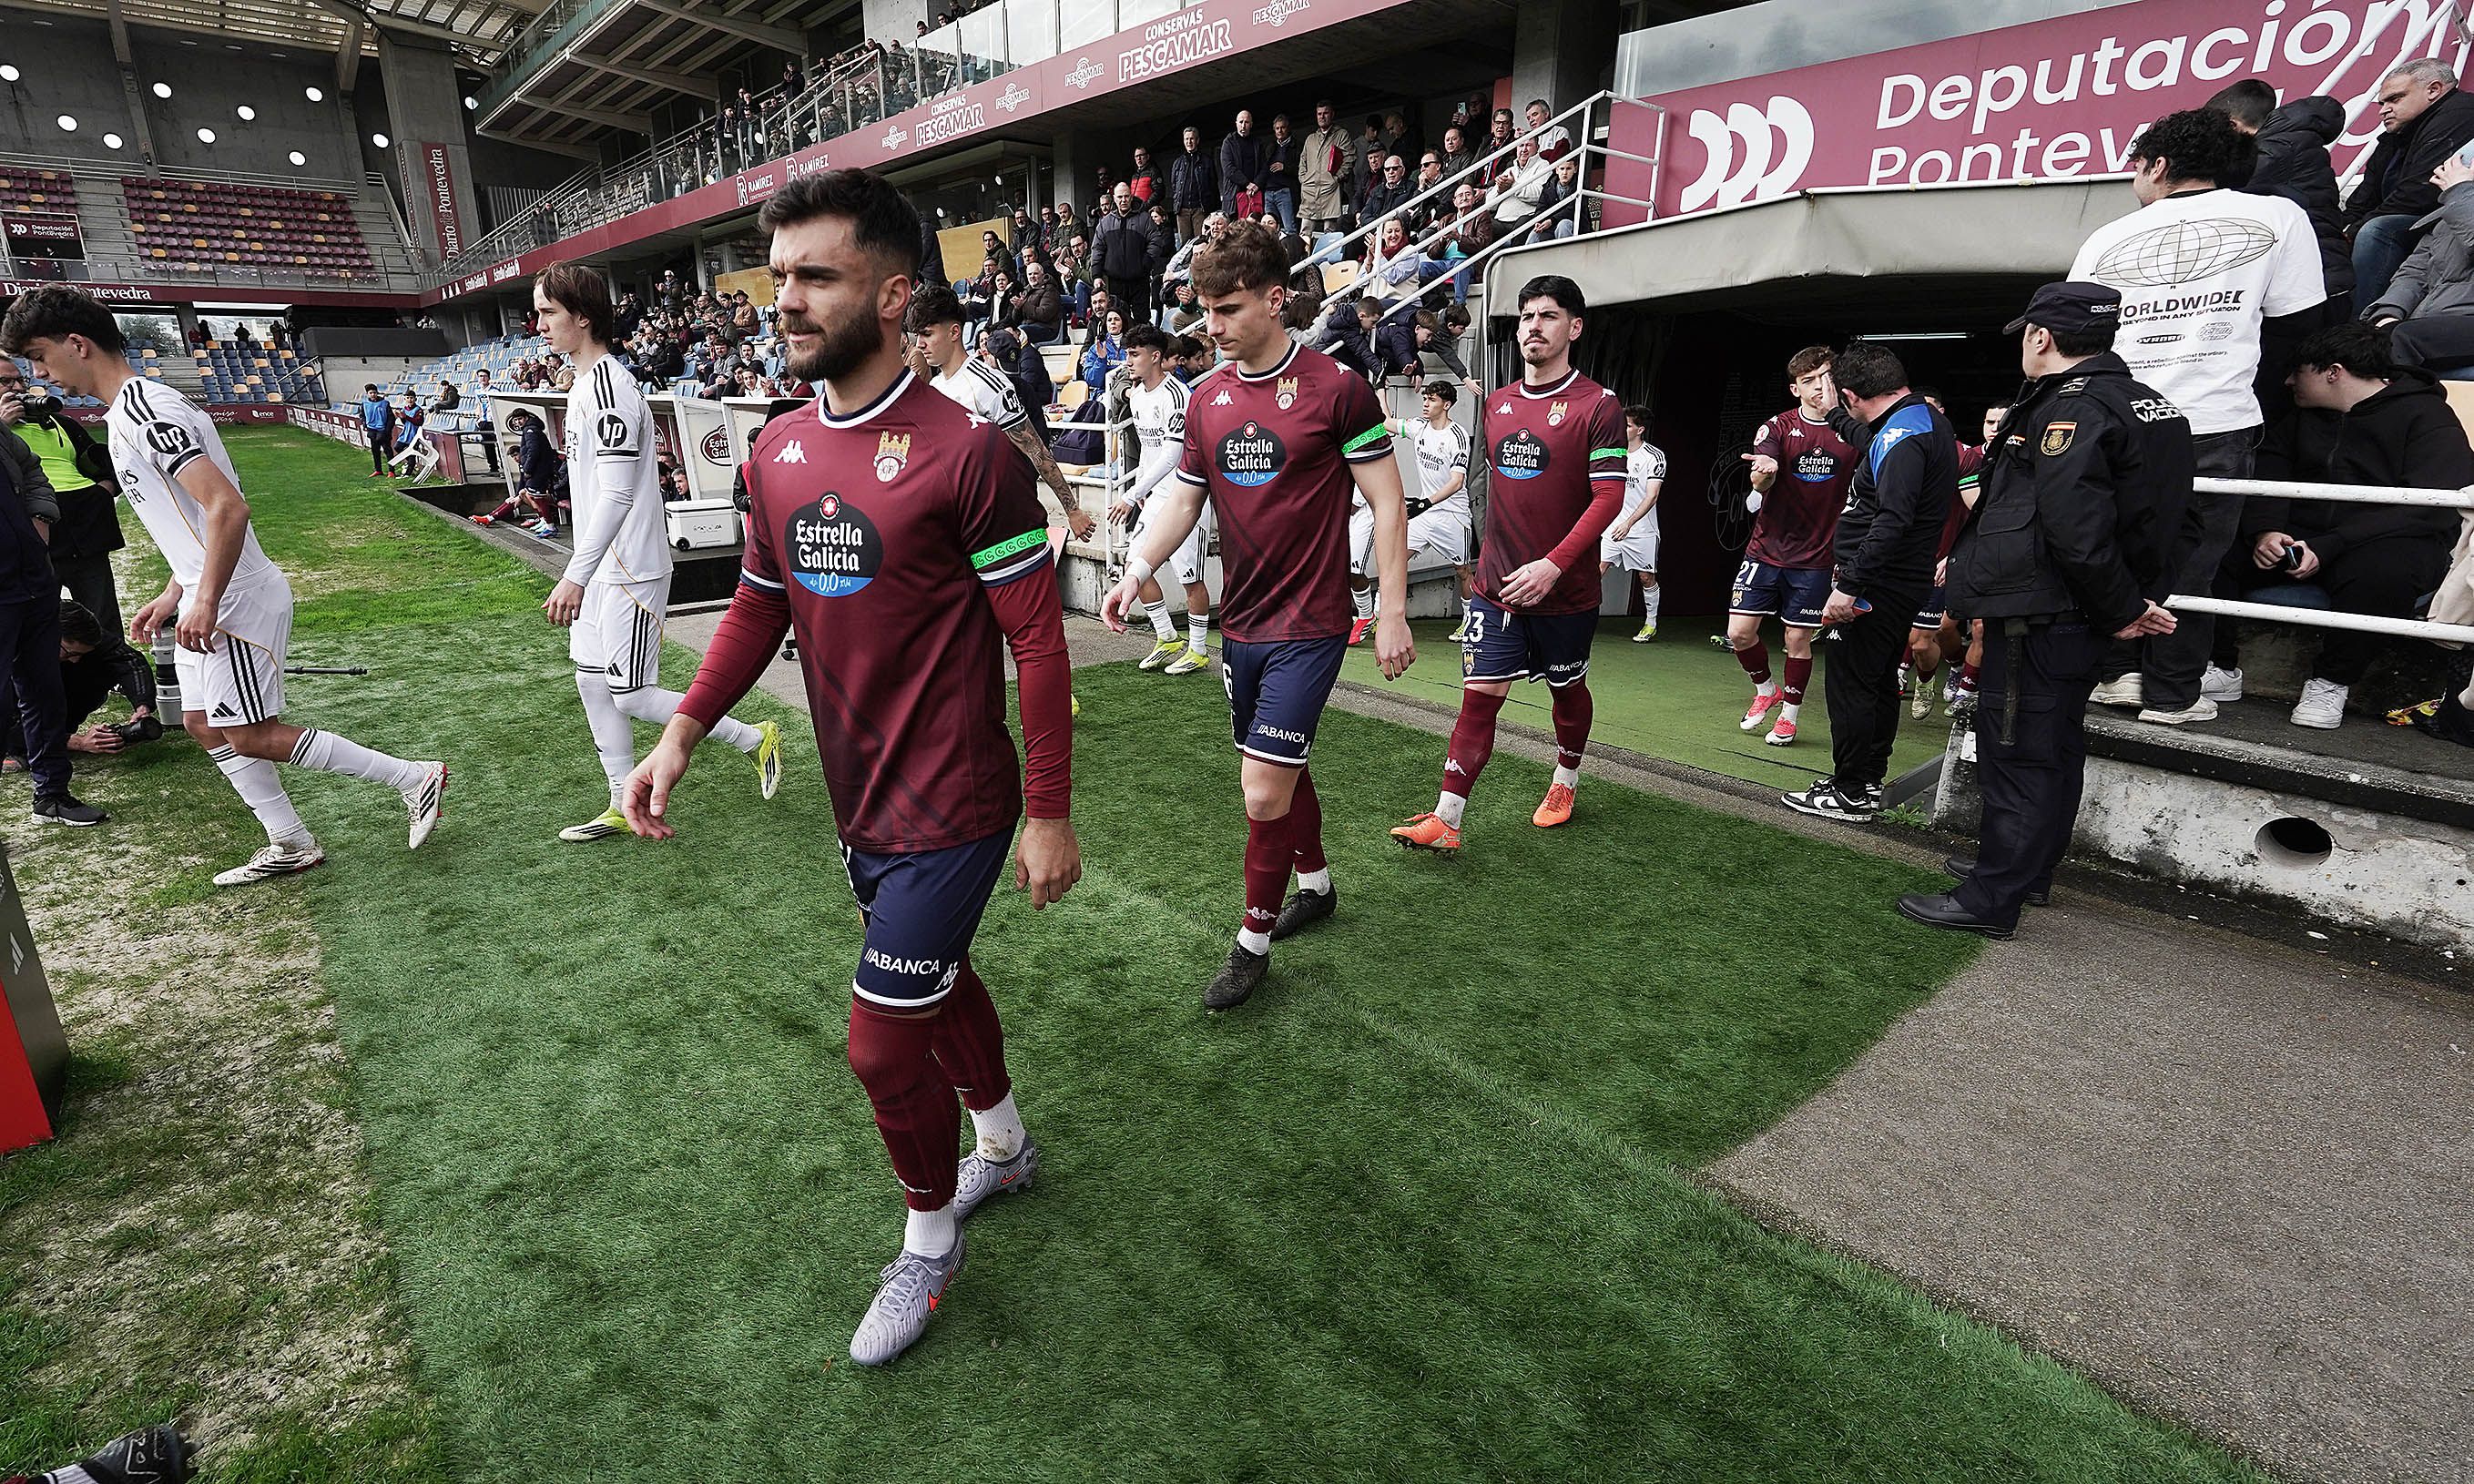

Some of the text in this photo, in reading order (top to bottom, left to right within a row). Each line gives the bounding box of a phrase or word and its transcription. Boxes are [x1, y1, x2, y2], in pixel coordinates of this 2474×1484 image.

[1145, 8, 1204, 41] CONSERVAS
[1117, 17, 1234, 83] PESCAMAR
[1064, 62, 1105, 87] PESCAMAR
[1876, 0, 2429, 134] Deputación
[931, 93, 967, 117] CONSERVAS
[995, 87, 1030, 110] PESCAMAR
[915, 102, 985, 147] PESCAMAR
[799, 153, 830, 177] RAMÍREZ
[430, 148, 453, 214] Pontevedra
[748, 174, 774, 193] RAMÍREZ
[2123, 315, 2159, 326] BEYOND
[2172, 311, 2194, 320] ANY
[148, 422, 186, 453] hp
[601, 413, 626, 448] hp
[708, 437, 728, 450] Estr
[711, 446, 729, 459] Gal
[1225, 439, 1274, 455] Estrella
[1502, 441, 1541, 456] Estrella
[1227, 453, 1272, 470] Galicia
[1502, 453, 1538, 469] Galicia
[1798, 455, 1834, 466] Estrella
[1798, 464, 1831, 474] Galicia
[1242, 470, 1257, 483] 0,0
[795, 519, 864, 547] Estrella
[799, 544, 860, 572] Galicia
[820, 572, 838, 592] 0,0
[1735, 560, 1759, 585] 21
[1461, 611, 1485, 643] 23
